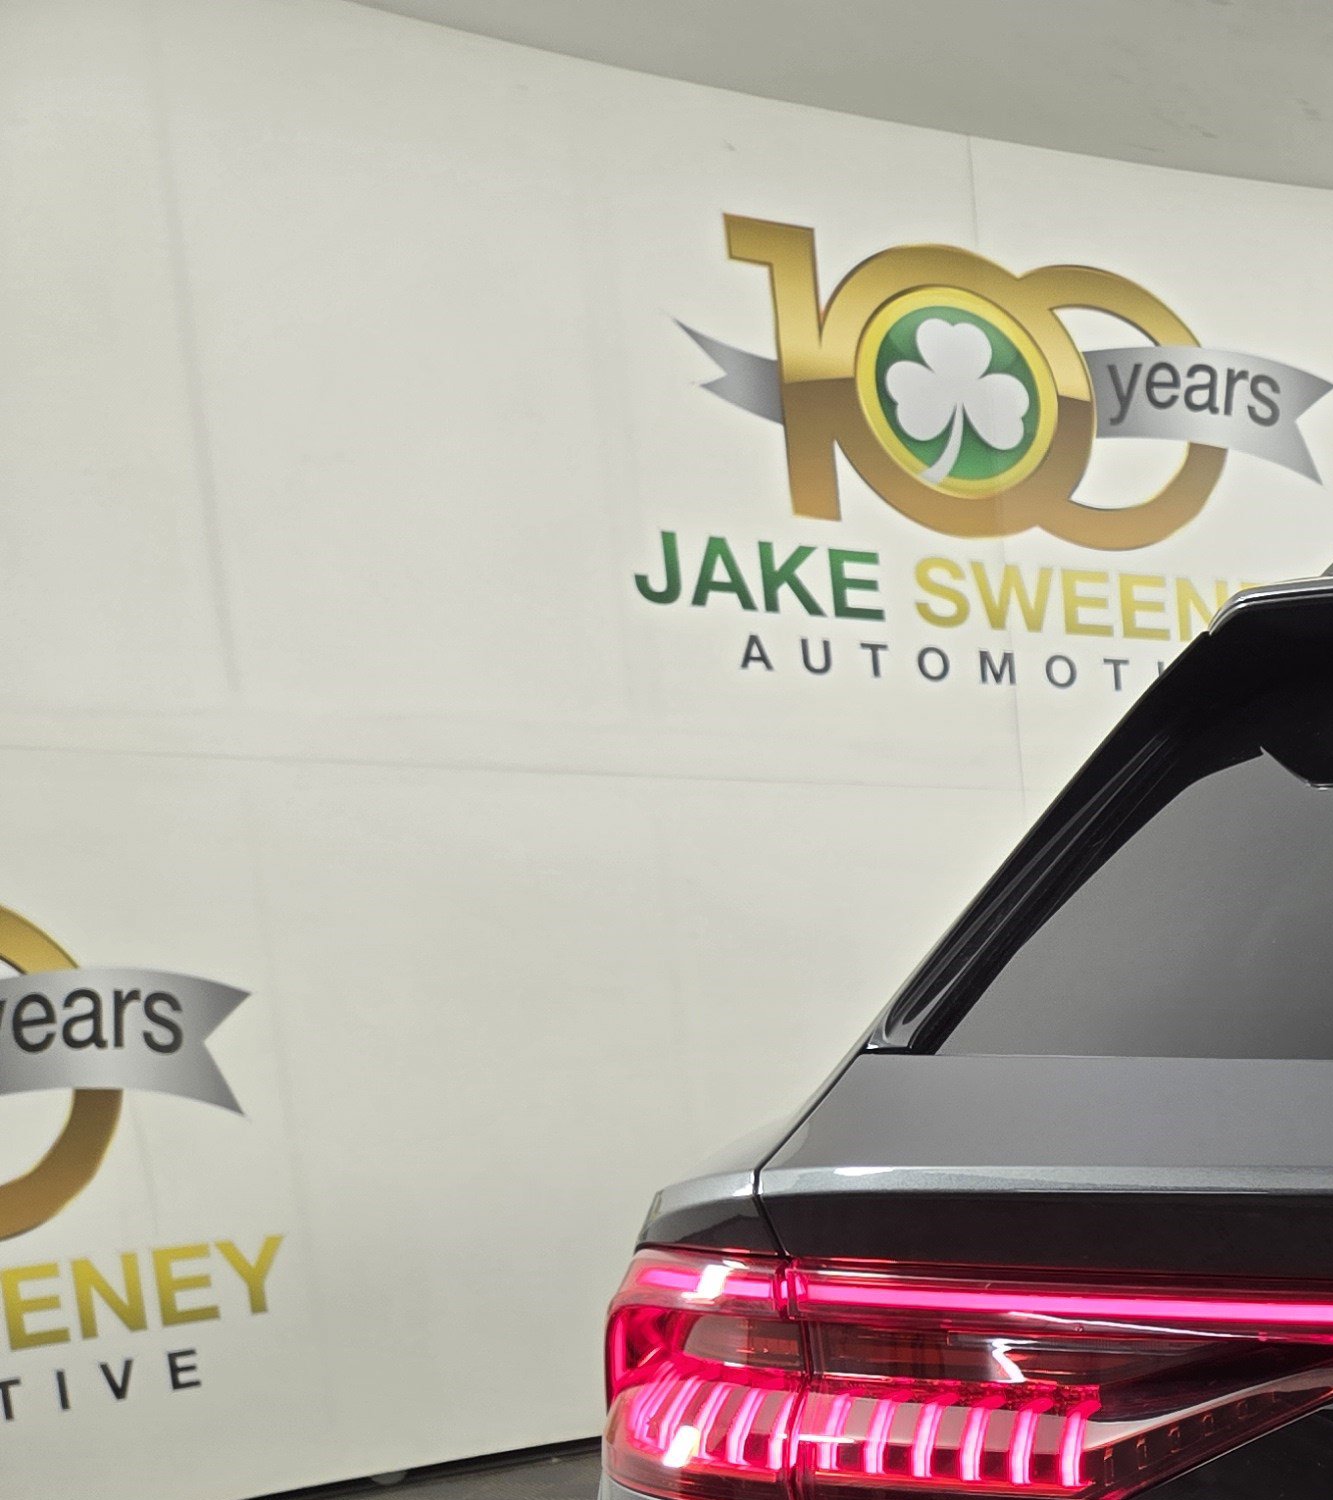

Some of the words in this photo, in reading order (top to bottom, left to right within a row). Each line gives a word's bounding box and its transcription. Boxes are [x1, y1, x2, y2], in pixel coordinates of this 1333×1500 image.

[1106, 360, 1281, 428] years
[634, 530, 886, 622] JAKE
[914, 557, 1265, 642] SWEEN
[0, 987, 184, 1055] ears
